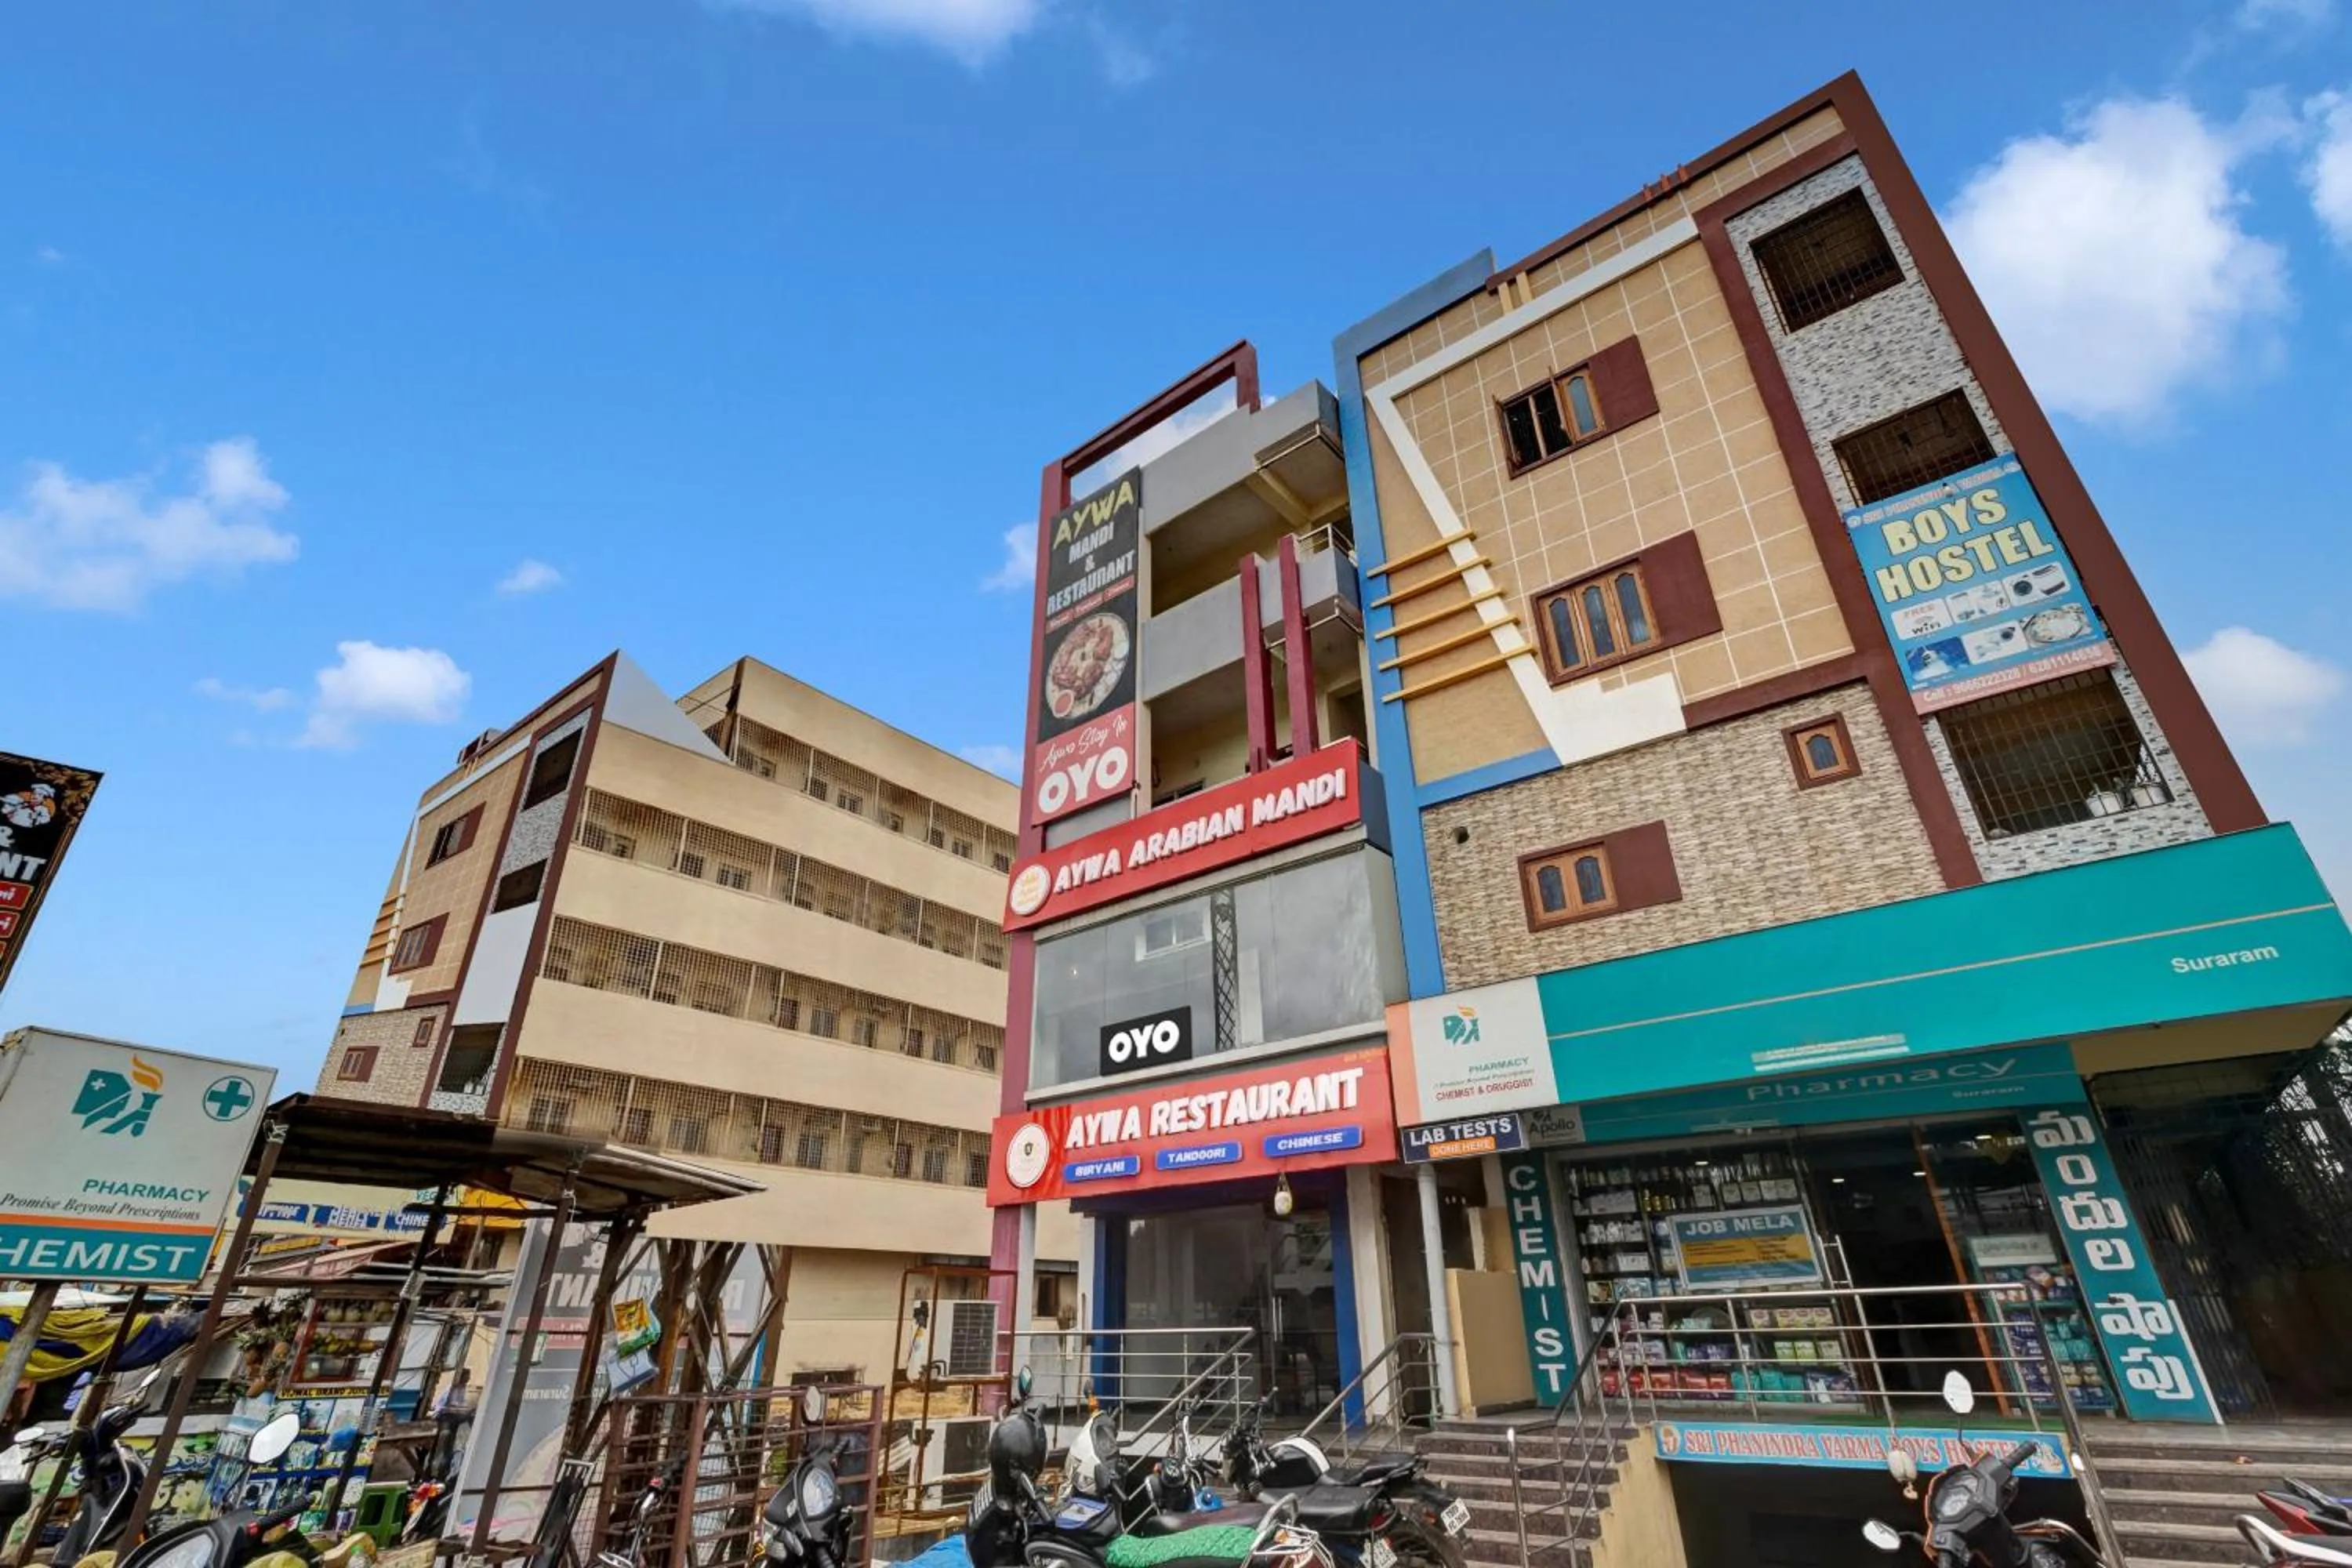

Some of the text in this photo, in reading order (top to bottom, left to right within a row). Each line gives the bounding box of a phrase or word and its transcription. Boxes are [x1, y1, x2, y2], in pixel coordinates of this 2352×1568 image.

[1053, 481, 1134, 549] AYWA
[1881, 488, 2007, 556] BOYS
[1069, 521, 1114, 564] MANDI
[1085, 554, 1095, 572] &
[1874, 520, 2055, 603] HOSTEL
[1047, 550, 1135, 617] RESTAURANT
[1039, 746, 1128, 813] OYO
[1054, 848, 1122, 895] AYWA
[1128, 803, 1245, 868] ARABIAN
[1253, 768, 1347, 825] MANDI
[2171, 944, 2278, 975] Suraram
[1109, 1020, 1179, 1062] OYO
[1748, 1054, 2016, 1102] Pharmacy
[1065, 1067, 1363, 1150] AYWA RESTAURANT
[1410, 1117, 1512, 1146] LAB TESTS
[1075, 1131, 1344, 1178] BIRYANI TANDOORI CHINESE
[1, 1192, 201, 1221] Promise Beyond Prescriptions
[82, 1179, 211, 1203] PHARMACY
[1686, 1214, 1795, 1236] JOB MELA
[1508, 1165, 1567, 1393] CHEMIST
[1685, 1430, 1713, 1454] SRI
[1715, 1431, 1820, 1457] PHANINDRA
[1820, 1434, 1888, 1461] VARMA
